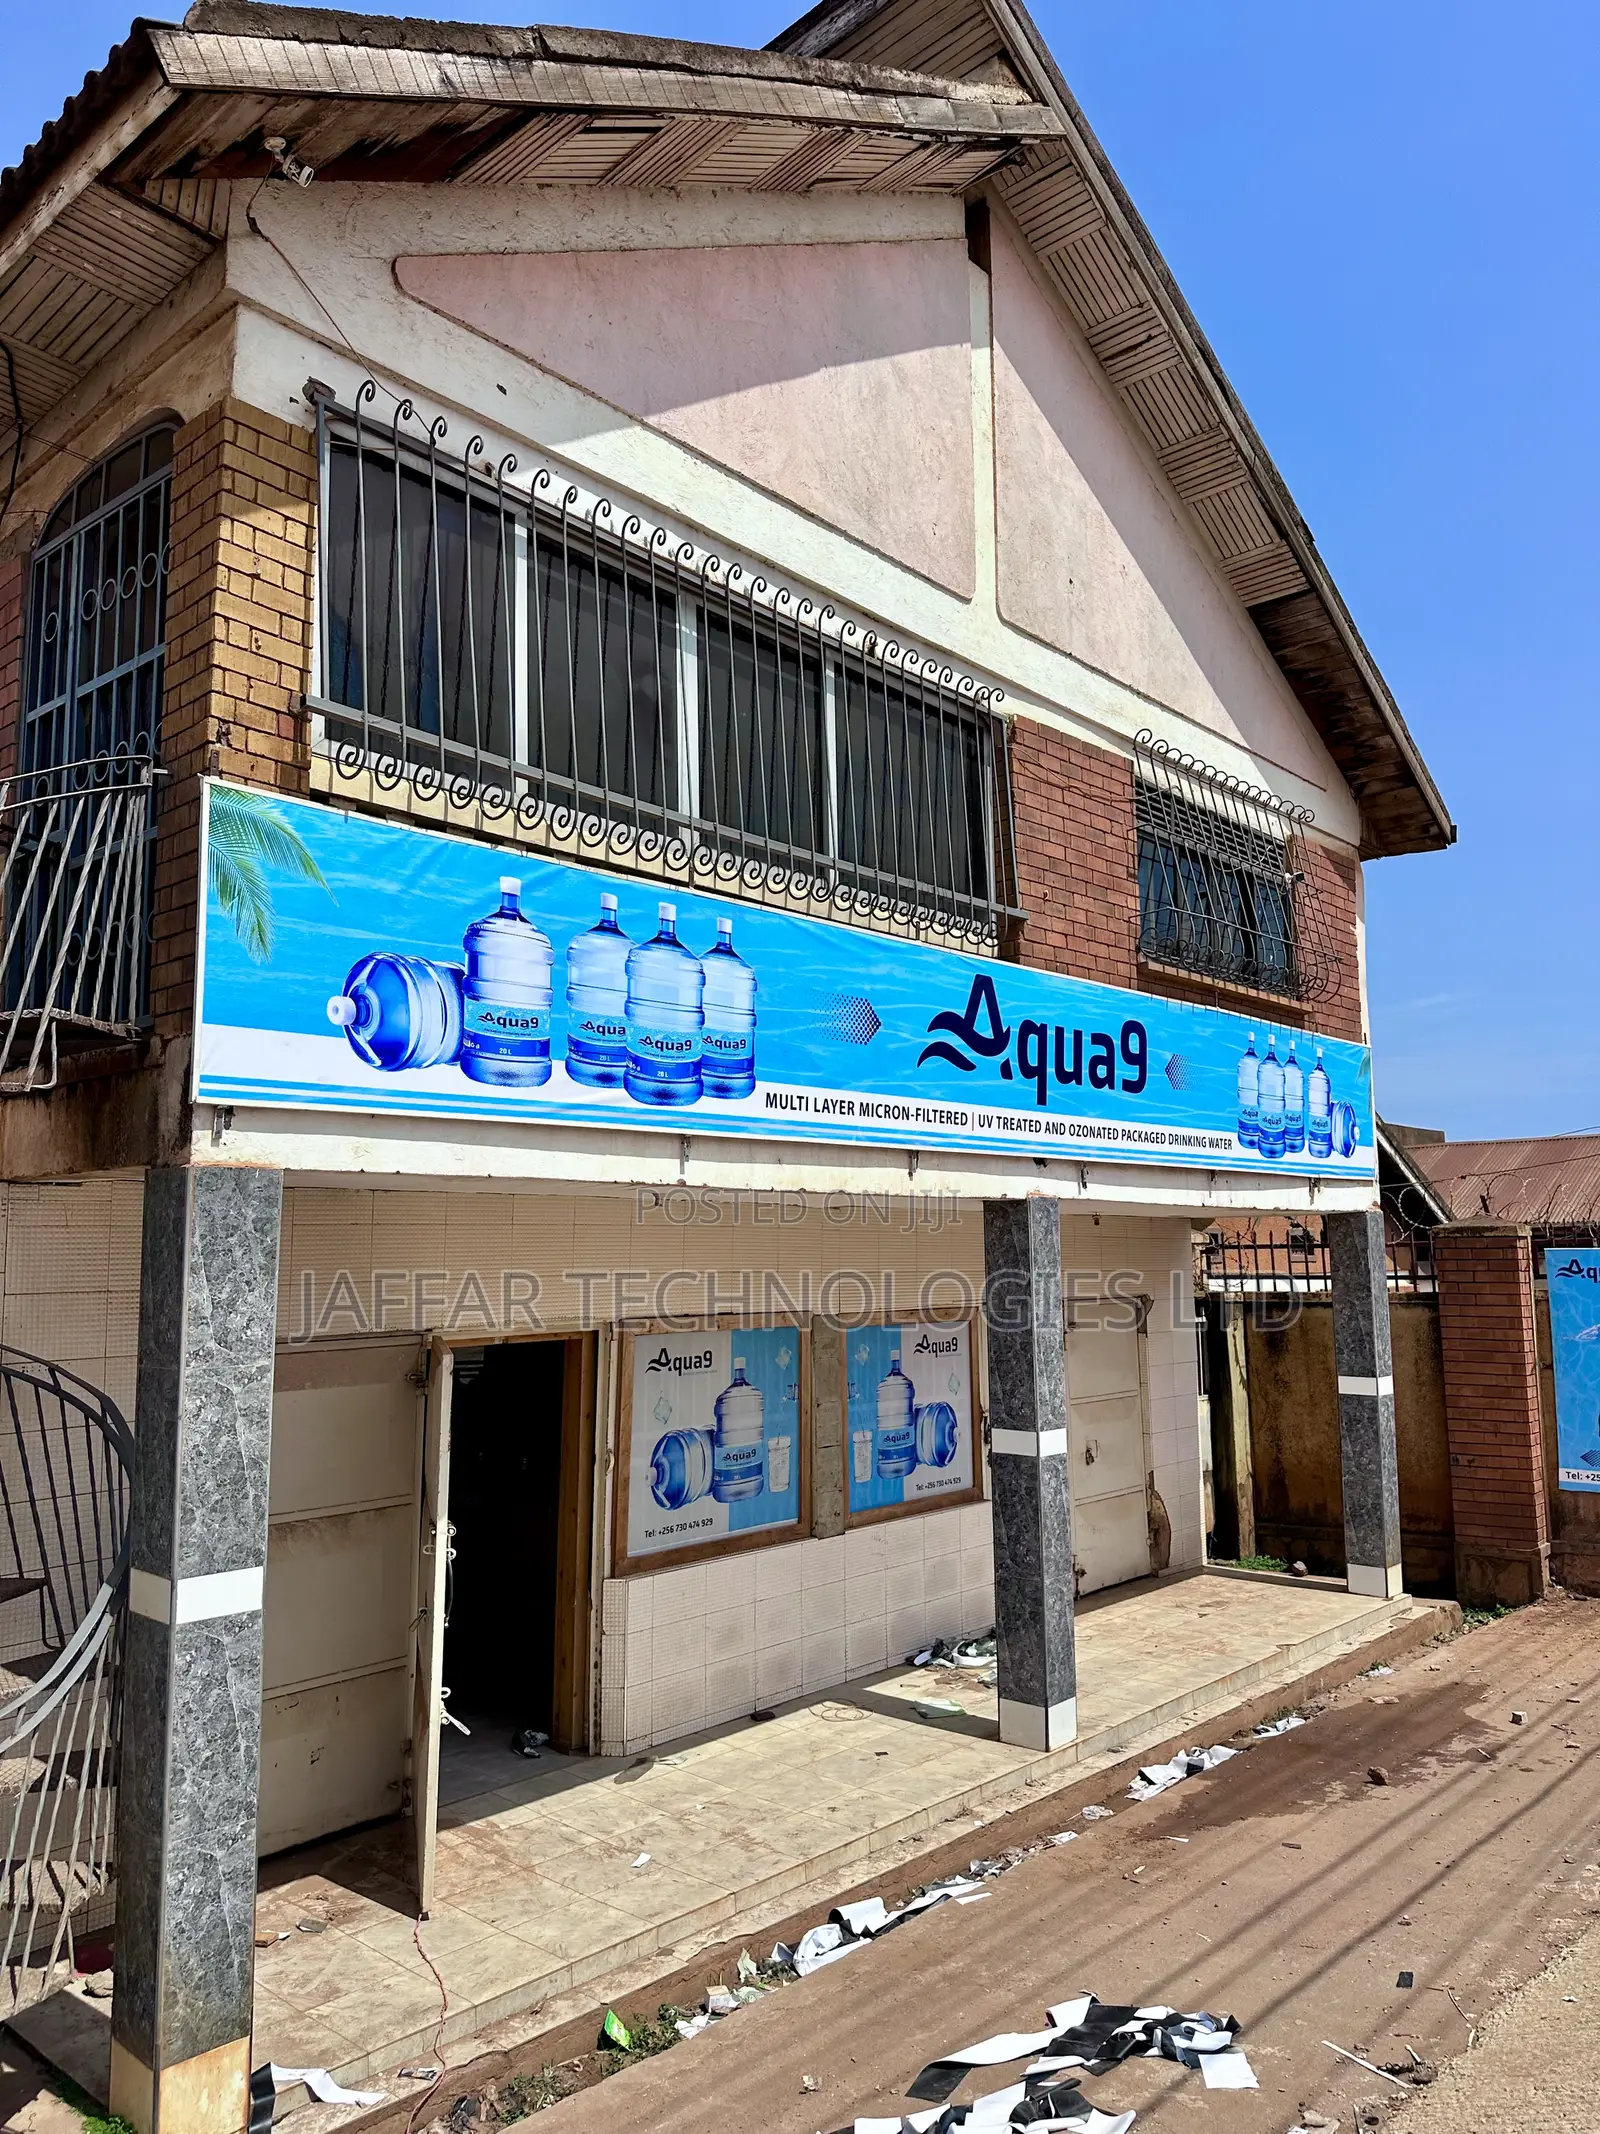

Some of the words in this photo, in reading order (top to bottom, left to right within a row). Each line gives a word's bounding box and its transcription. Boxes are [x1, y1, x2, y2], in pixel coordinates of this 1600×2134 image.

[477, 1012, 539, 1029] Aqua9
[638, 1035, 692, 1051] Aqua9
[702, 1035, 747, 1050] Aqua9
[917, 973, 1148, 1106] Aqua9
[765, 1092, 809, 1112] MULTI
[814, 1097, 855, 1116] LAYER
[859, 1102, 968, 1126] MICRON-FILTERED
[978, 1113, 994, 1129] UV
[996, 1116, 1042, 1133] TREATED
[1044, 1121, 1066, 1136] AND
[1069, 1124, 1119, 1141] OZONATED
[1121, 1129, 1166, 1144] PACKAGED
[1168, 1133, 1207, 1149] DRINKING
[1208, 1137, 1233, 1150] WATER
[1555, 1259, 1600, 1283] Aq
[913, 1334, 958, 1358] Aqua9
[645, 1348, 713, 1376] Aqua9
[884, 1432, 910, 1443] Aqua9
[722, 1448, 757, 1462] Aqua9
[1566, 1471, 1583, 1480] Tel:
[645, 1529, 657, 1538] Tel:
[658, 1525, 674, 1535] +256
[675, 1522, 687, 1532] 730
[688, 1520, 700, 1529] 474
[701, 1518, 713, 1527] 929
